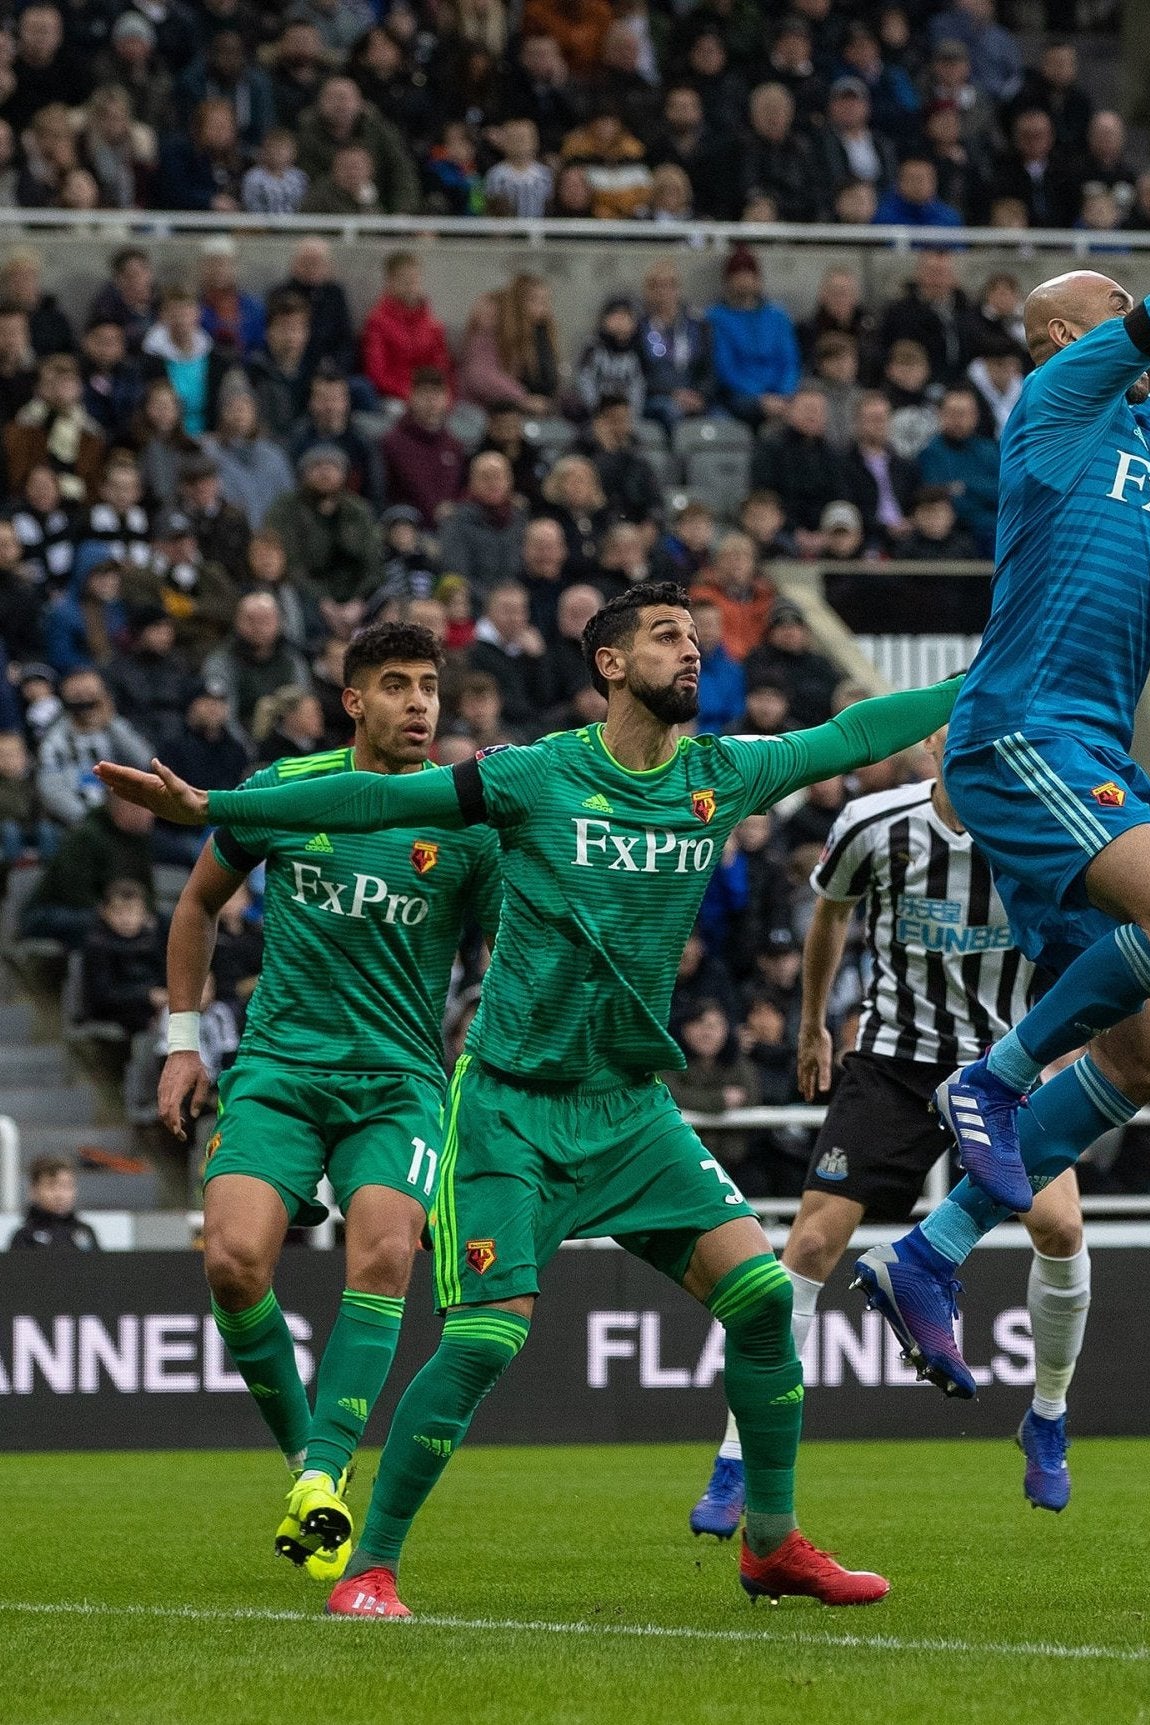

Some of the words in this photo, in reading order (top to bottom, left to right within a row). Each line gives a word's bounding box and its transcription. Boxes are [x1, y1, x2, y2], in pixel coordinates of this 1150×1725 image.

[571, 817, 714, 872] FxPro
[291, 861, 429, 926] FxPro
[406, 1136, 437, 1196] 11
[0, 1313, 316, 1394] NNELS
[587, 1310, 1036, 1387] FLANS
